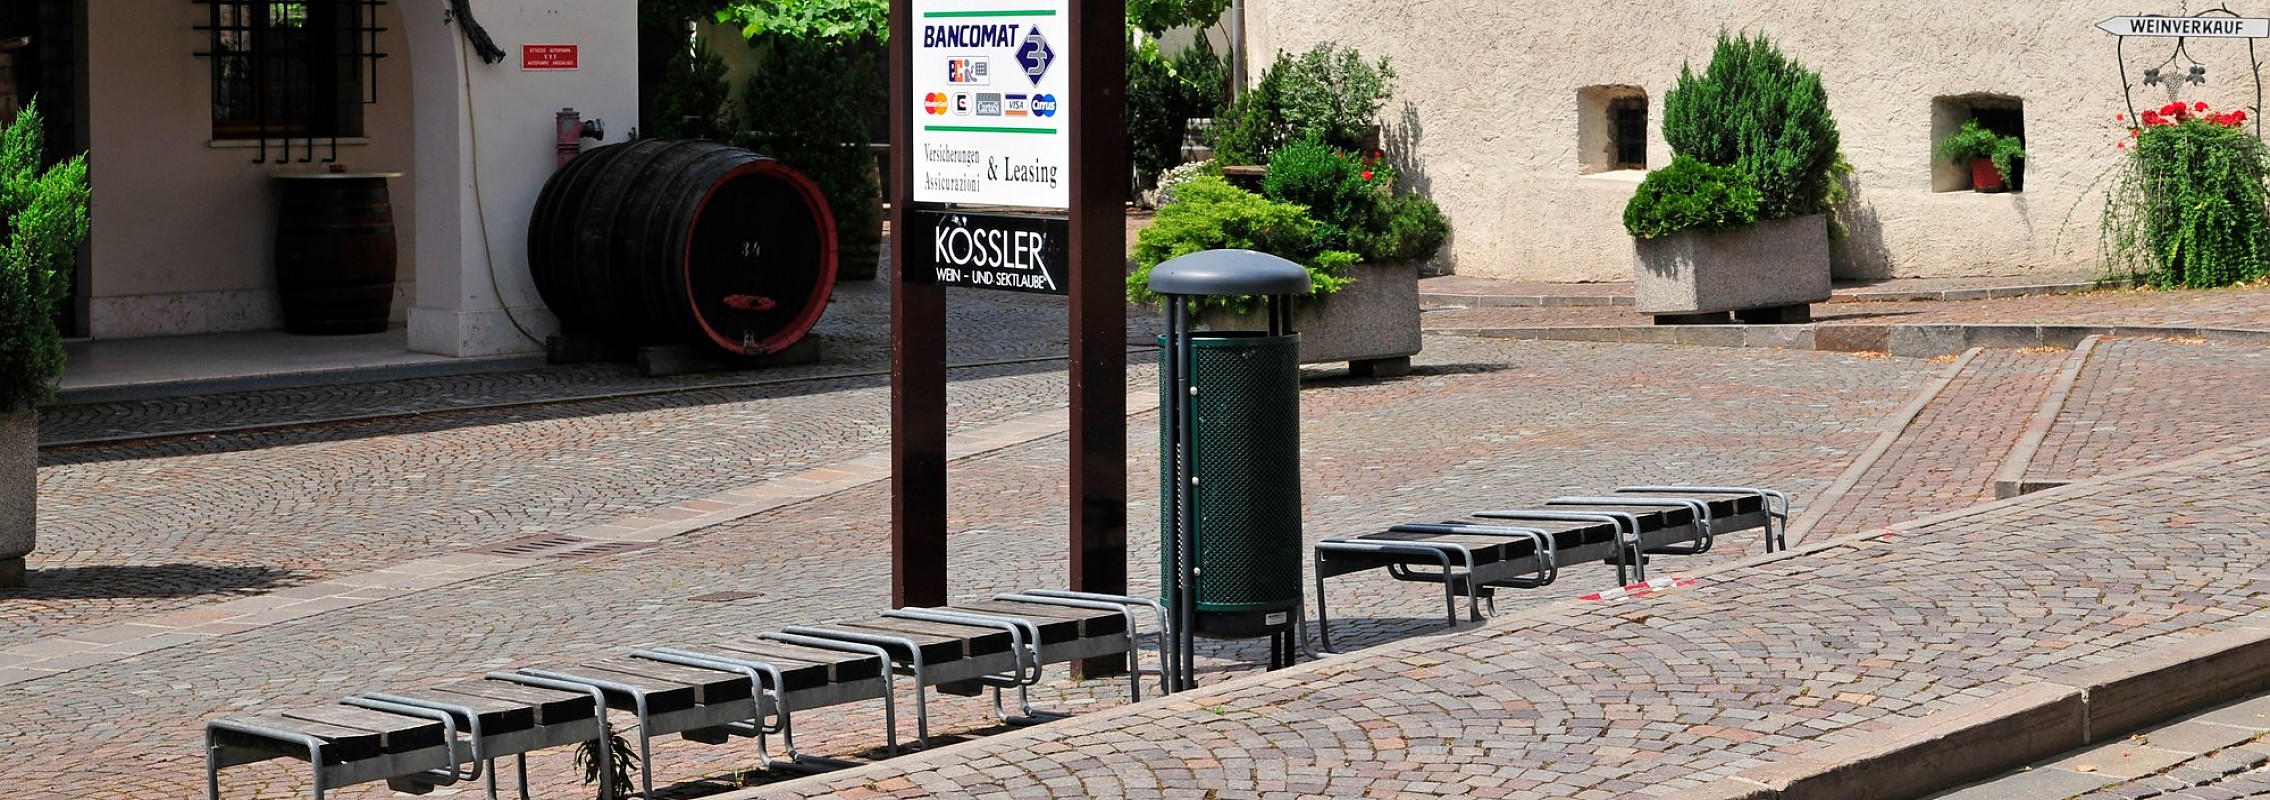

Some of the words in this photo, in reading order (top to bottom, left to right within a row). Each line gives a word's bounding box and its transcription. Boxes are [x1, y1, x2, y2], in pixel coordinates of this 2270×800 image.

[924, 24, 1019, 48] BANCOMAT
[2130, 19, 2243, 34] WEINVERKAUF
[1008, 101, 1024, 110] VISA
[1032, 99, 1056, 111] Cirrus
[924, 143, 980, 167] Versicherungen
[924, 171, 980, 192] Assicurazioni
[987, 155, 998, 181] &
[1004, 157, 1057, 189] Leasing
[935, 216, 1056, 291] KÖSSLER
[936, 267, 961, 282] WEIN
[971, 270, 994, 285] UND
[995, 272, 1045, 290] SEKTLAUBE
